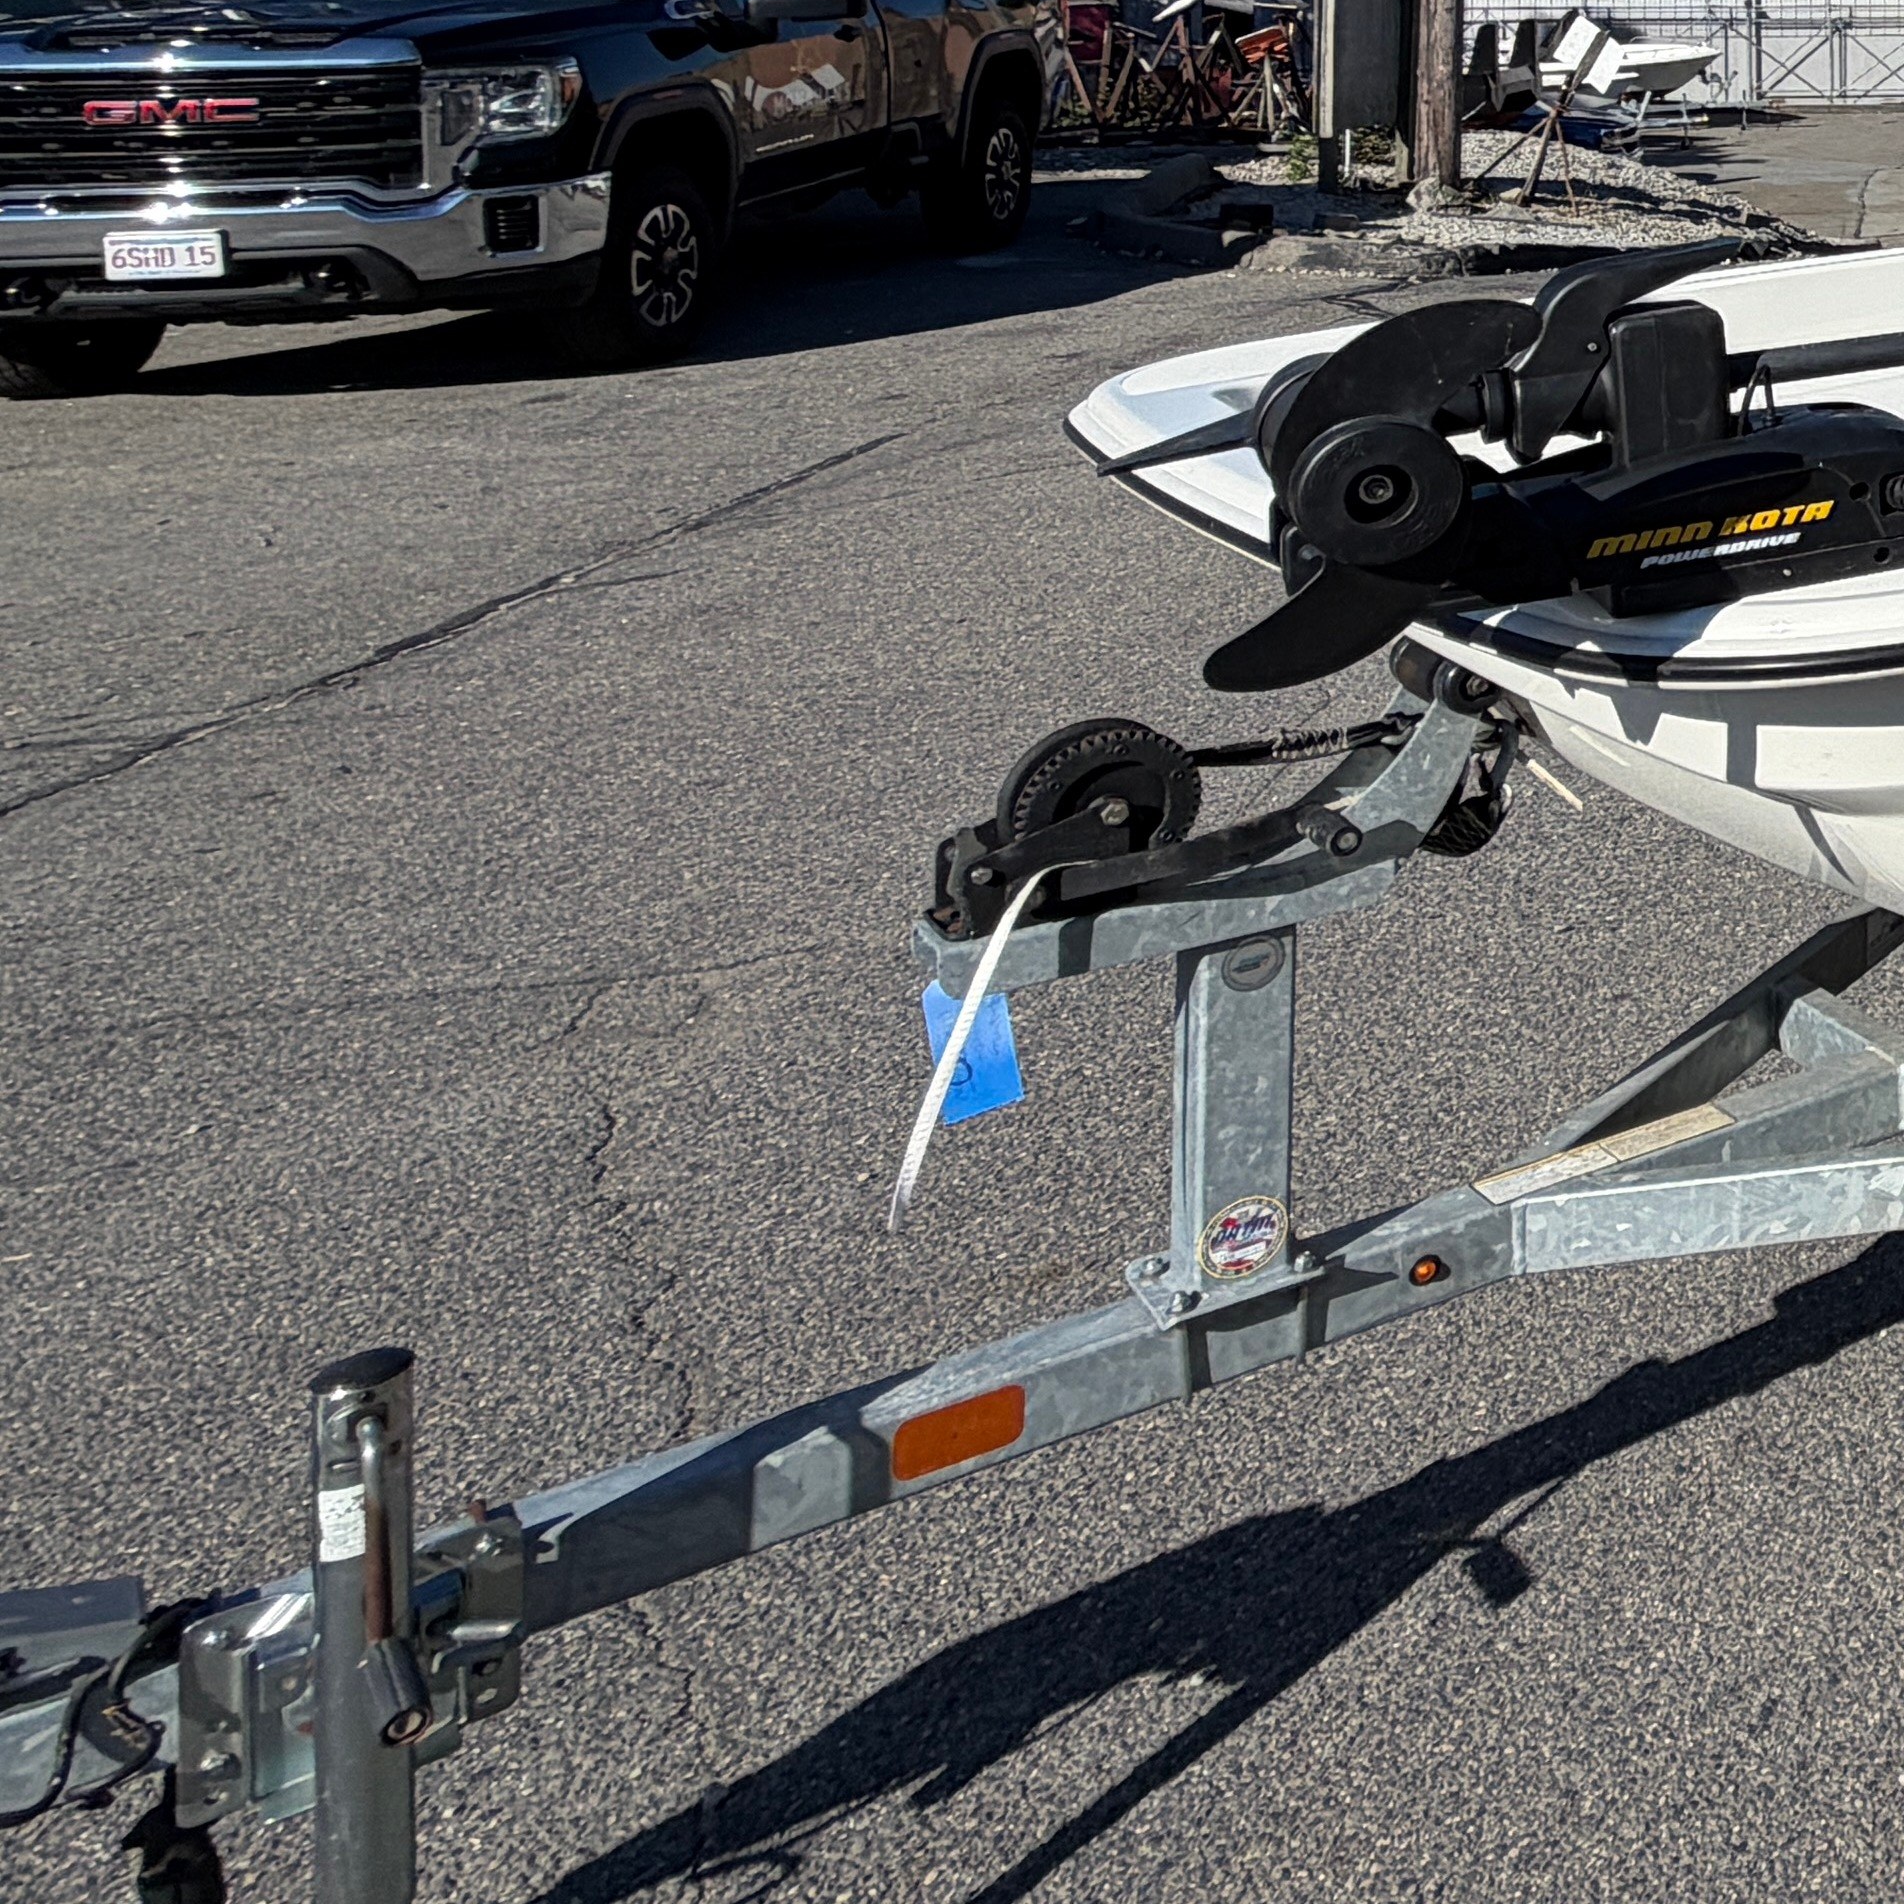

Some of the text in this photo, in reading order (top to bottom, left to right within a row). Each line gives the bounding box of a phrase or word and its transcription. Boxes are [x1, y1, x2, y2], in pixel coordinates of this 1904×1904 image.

[83, 98, 259, 126] GMC
[184, 245, 216, 267] 15
[1586, 500, 1835, 559] MINN KOTA
[1640, 532, 1802, 570] POWERDRIVE
